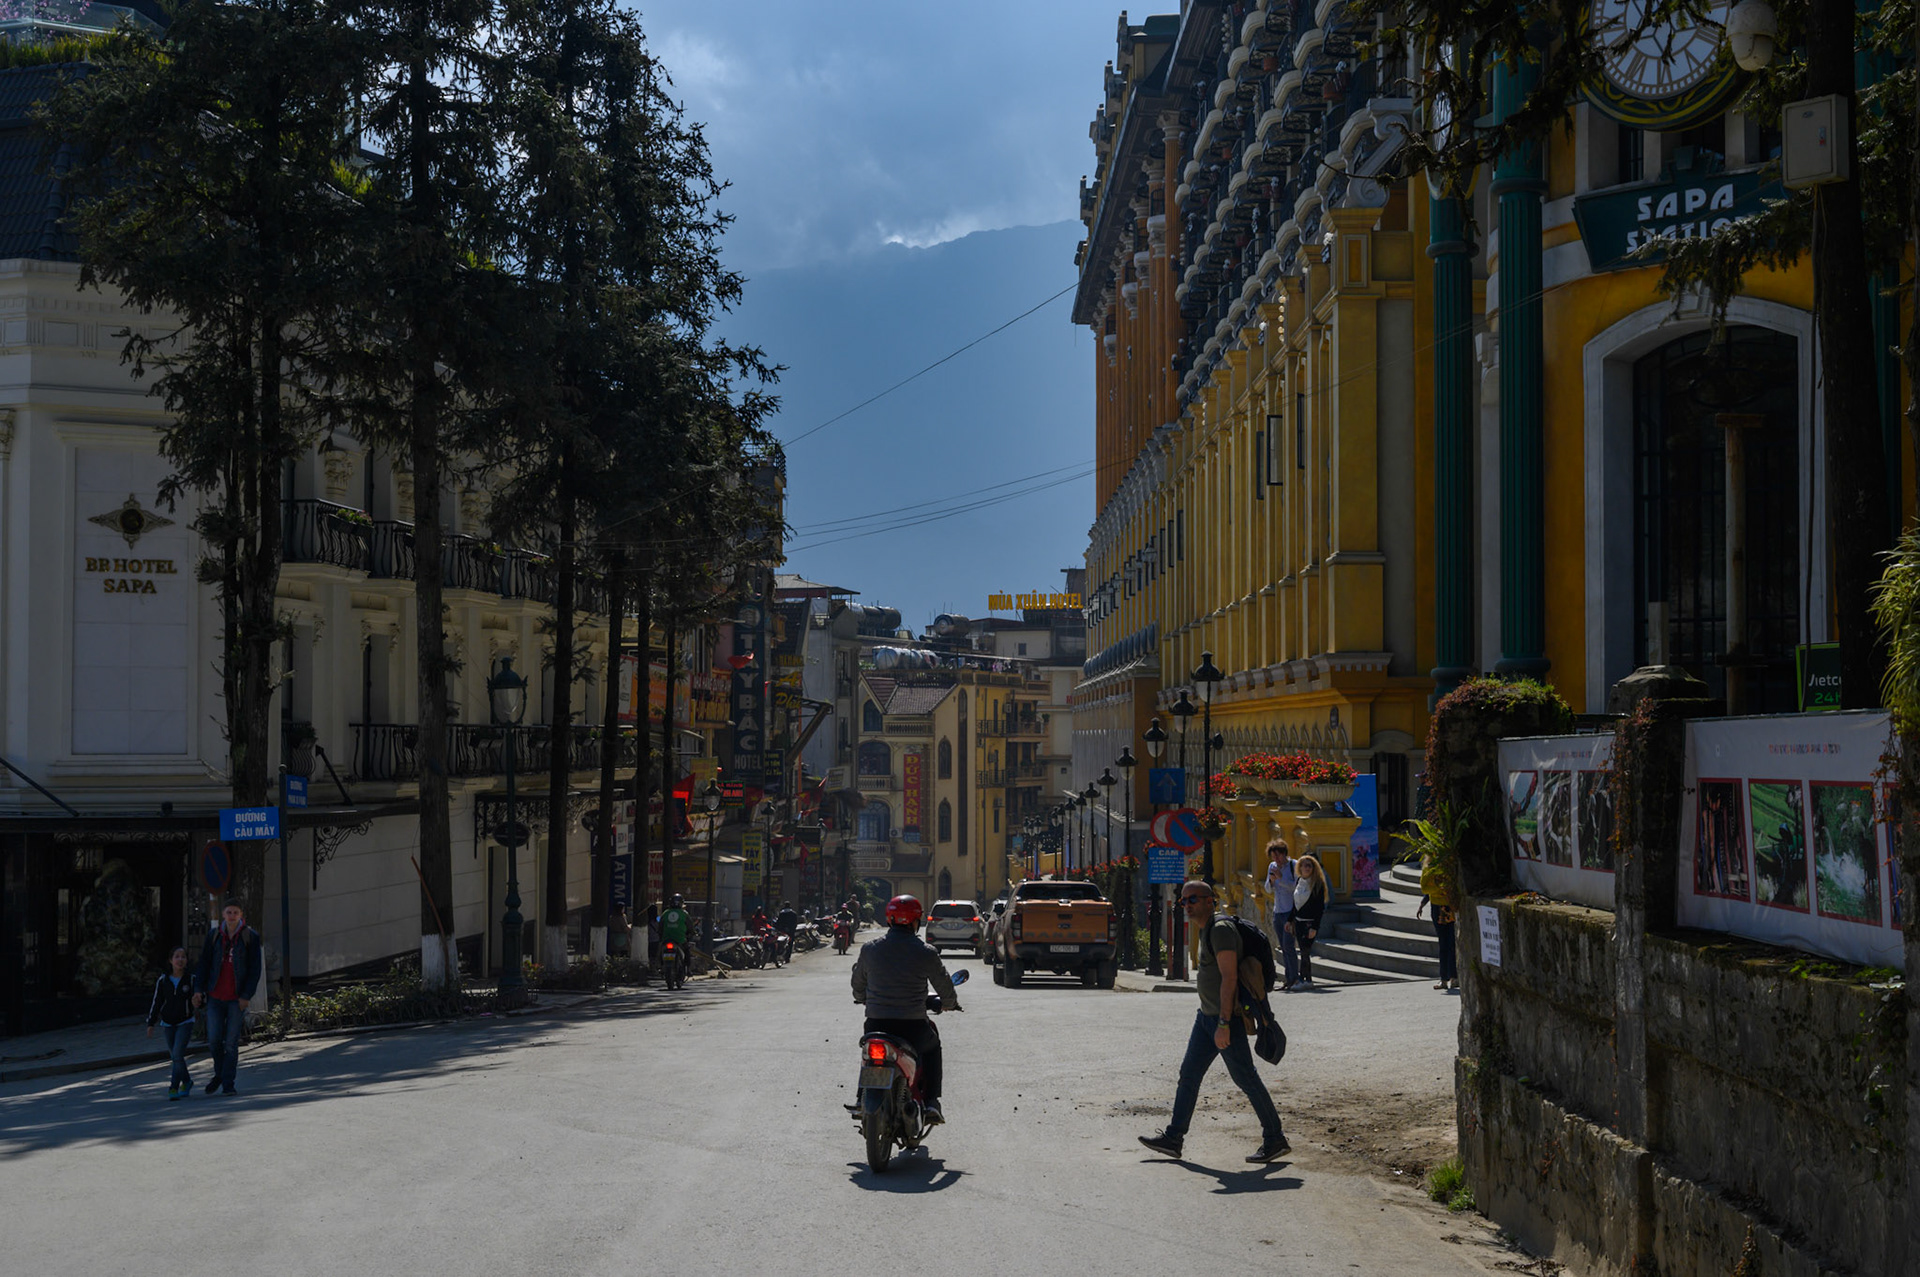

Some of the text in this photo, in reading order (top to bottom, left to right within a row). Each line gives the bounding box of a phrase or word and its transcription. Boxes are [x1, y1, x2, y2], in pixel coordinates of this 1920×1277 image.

[1636, 182, 1734, 222] SAPA
[1626, 215, 1756, 254] STATIO
[85, 557, 178, 574] BR HOTEL
[104, 579, 157, 594] SAPA
[988, 589, 1084, 610] MÙA XUÂN HOTEL
[734, 754, 762, 770] HOTEL
[235, 808, 266, 823] ĐƯỜNG
[234, 823, 275, 838] CẦU MÂY
[613, 860, 627, 898] ATM
